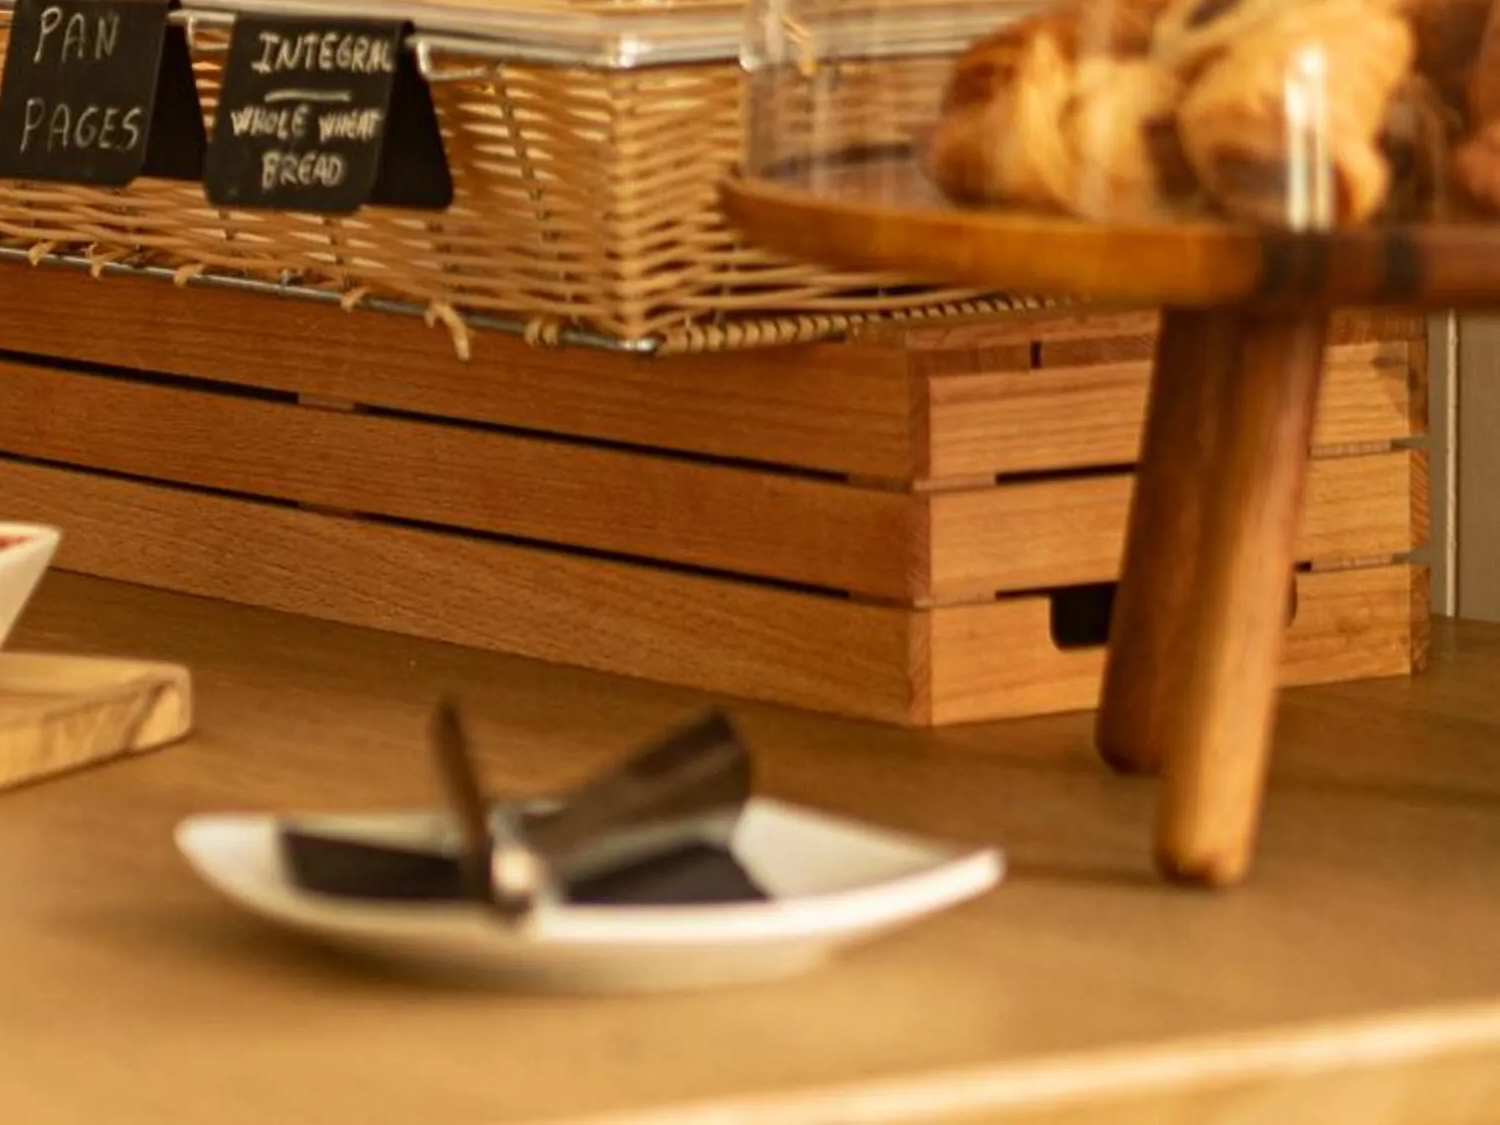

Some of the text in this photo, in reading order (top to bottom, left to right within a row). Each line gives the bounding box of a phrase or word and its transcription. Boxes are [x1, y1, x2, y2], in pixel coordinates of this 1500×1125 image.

[33, 5, 120, 63] PAN
[251, 30, 394, 74] INTEGRAL
[20, 96, 142, 153] PAGES
[230, 103, 310, 140] WHOLE
[261, 150, 346, 190] BREAD
